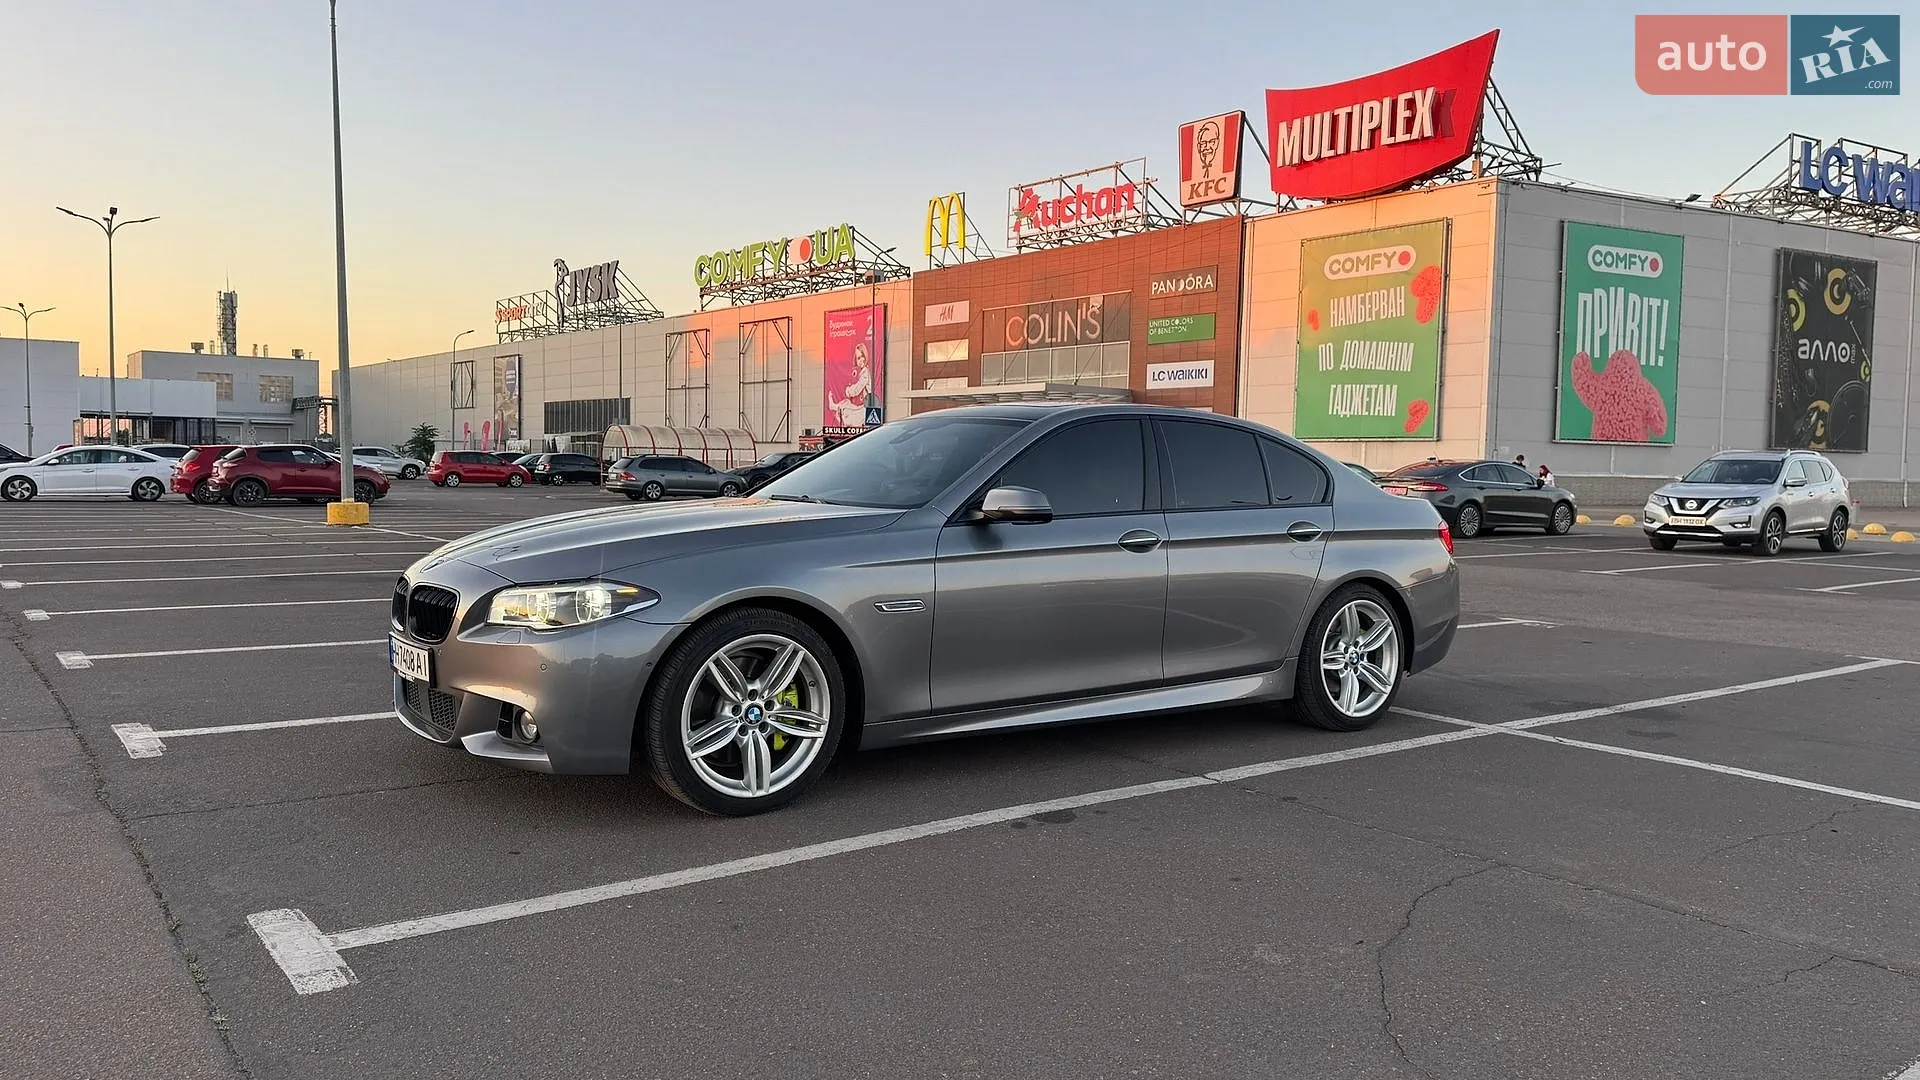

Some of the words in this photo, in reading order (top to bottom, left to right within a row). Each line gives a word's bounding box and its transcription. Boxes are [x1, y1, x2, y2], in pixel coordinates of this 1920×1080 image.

[1277, 87, 1436, 168] MULTIPLEX
[1188, 177, 1226, 200] KFC
[1800, 140, 1849, 197] LC
[1013, 184, 1134, 232] Auchan
[694, 237, 788, 288] COMFY
[815, 223, 855, 265] UA
[1329, 251, 1396, 275] COMFY
[1592, 250, 1648, 271] COMFY
[566, 260, 619, 307] JYSK
[1151, 274, 1214, 295] PANDORA
[1006, 303, 1101, 346] COLIN'S
[1330, 286, 1405, 328] НАМБЕРВАН
[1577, 287, 1669, 367] ПРИВІТ!
[1152, 370, 1166, 381] LC
[1318, 343, 1334, 371] ПО
[1340, 340, 1414, 372] ДОМАШНІМ
[1328, 384, 1398, 418] ГАДЖЕТАМ
